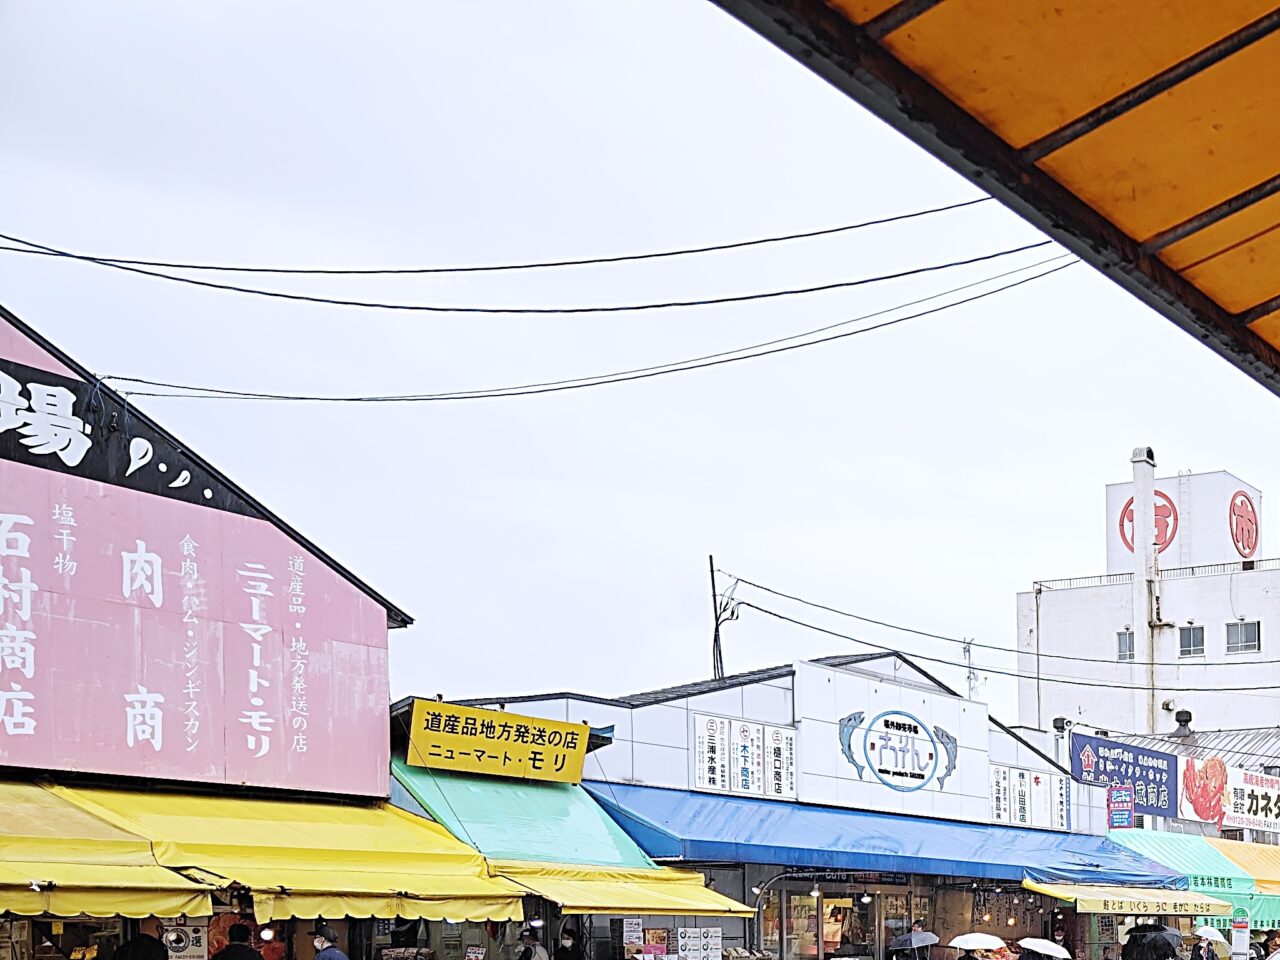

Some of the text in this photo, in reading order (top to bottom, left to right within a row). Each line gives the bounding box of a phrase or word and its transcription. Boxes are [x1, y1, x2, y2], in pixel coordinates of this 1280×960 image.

[53, 503, 78, 576] 塩干物
[235, 563, 275, 758] ニューマート・モリ
[288, 556, 309, 753] 道産品・地方発送の店
[424, 711, 580, 750] 道産品地方発送の店
[428, 744, 567, 772] ニューマート・モリ
[740, 744, 750, 790] 木下商店
[1129, 901, 1149, 912] いくら
[1155, 902, 1167, 912] うに
[1172, 903, 1189, 912] 毛がに
[1193, 903, 1211, 912] たらば
